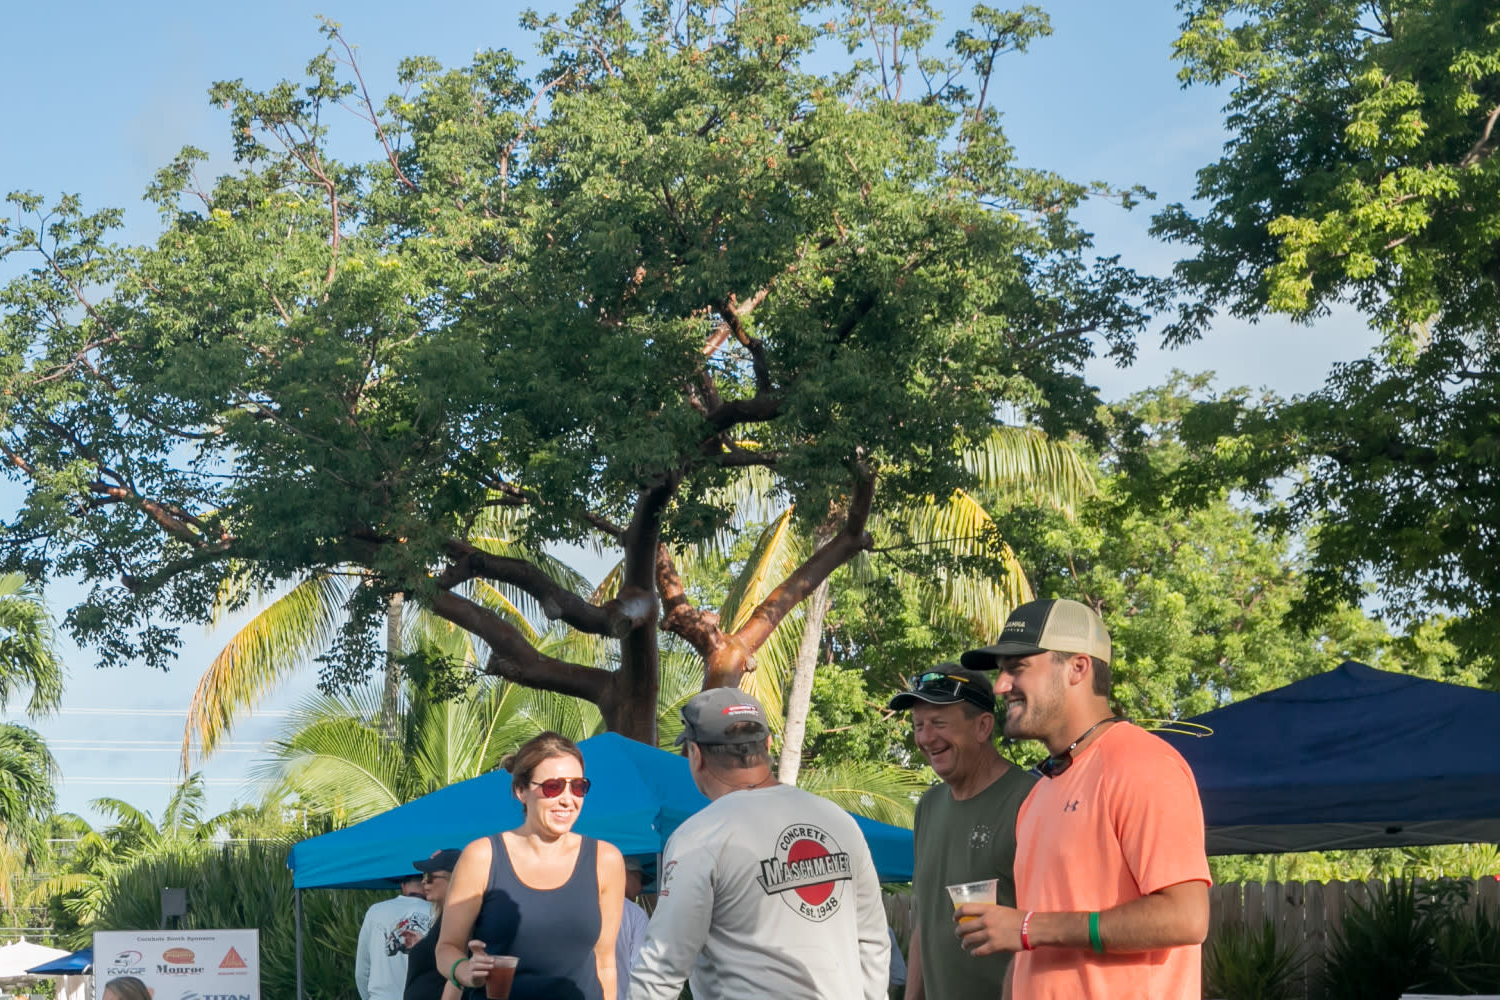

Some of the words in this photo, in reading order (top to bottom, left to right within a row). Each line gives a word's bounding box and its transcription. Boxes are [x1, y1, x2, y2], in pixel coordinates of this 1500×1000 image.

[780, 827, 828, 852] CONCRETE
[760, 852, 852, 888] MASCHMEYER
[799, 902, 817, 919] Est.
[816, 896, 839, 919] 1948
[156, 965, 205, 974] Monroe
